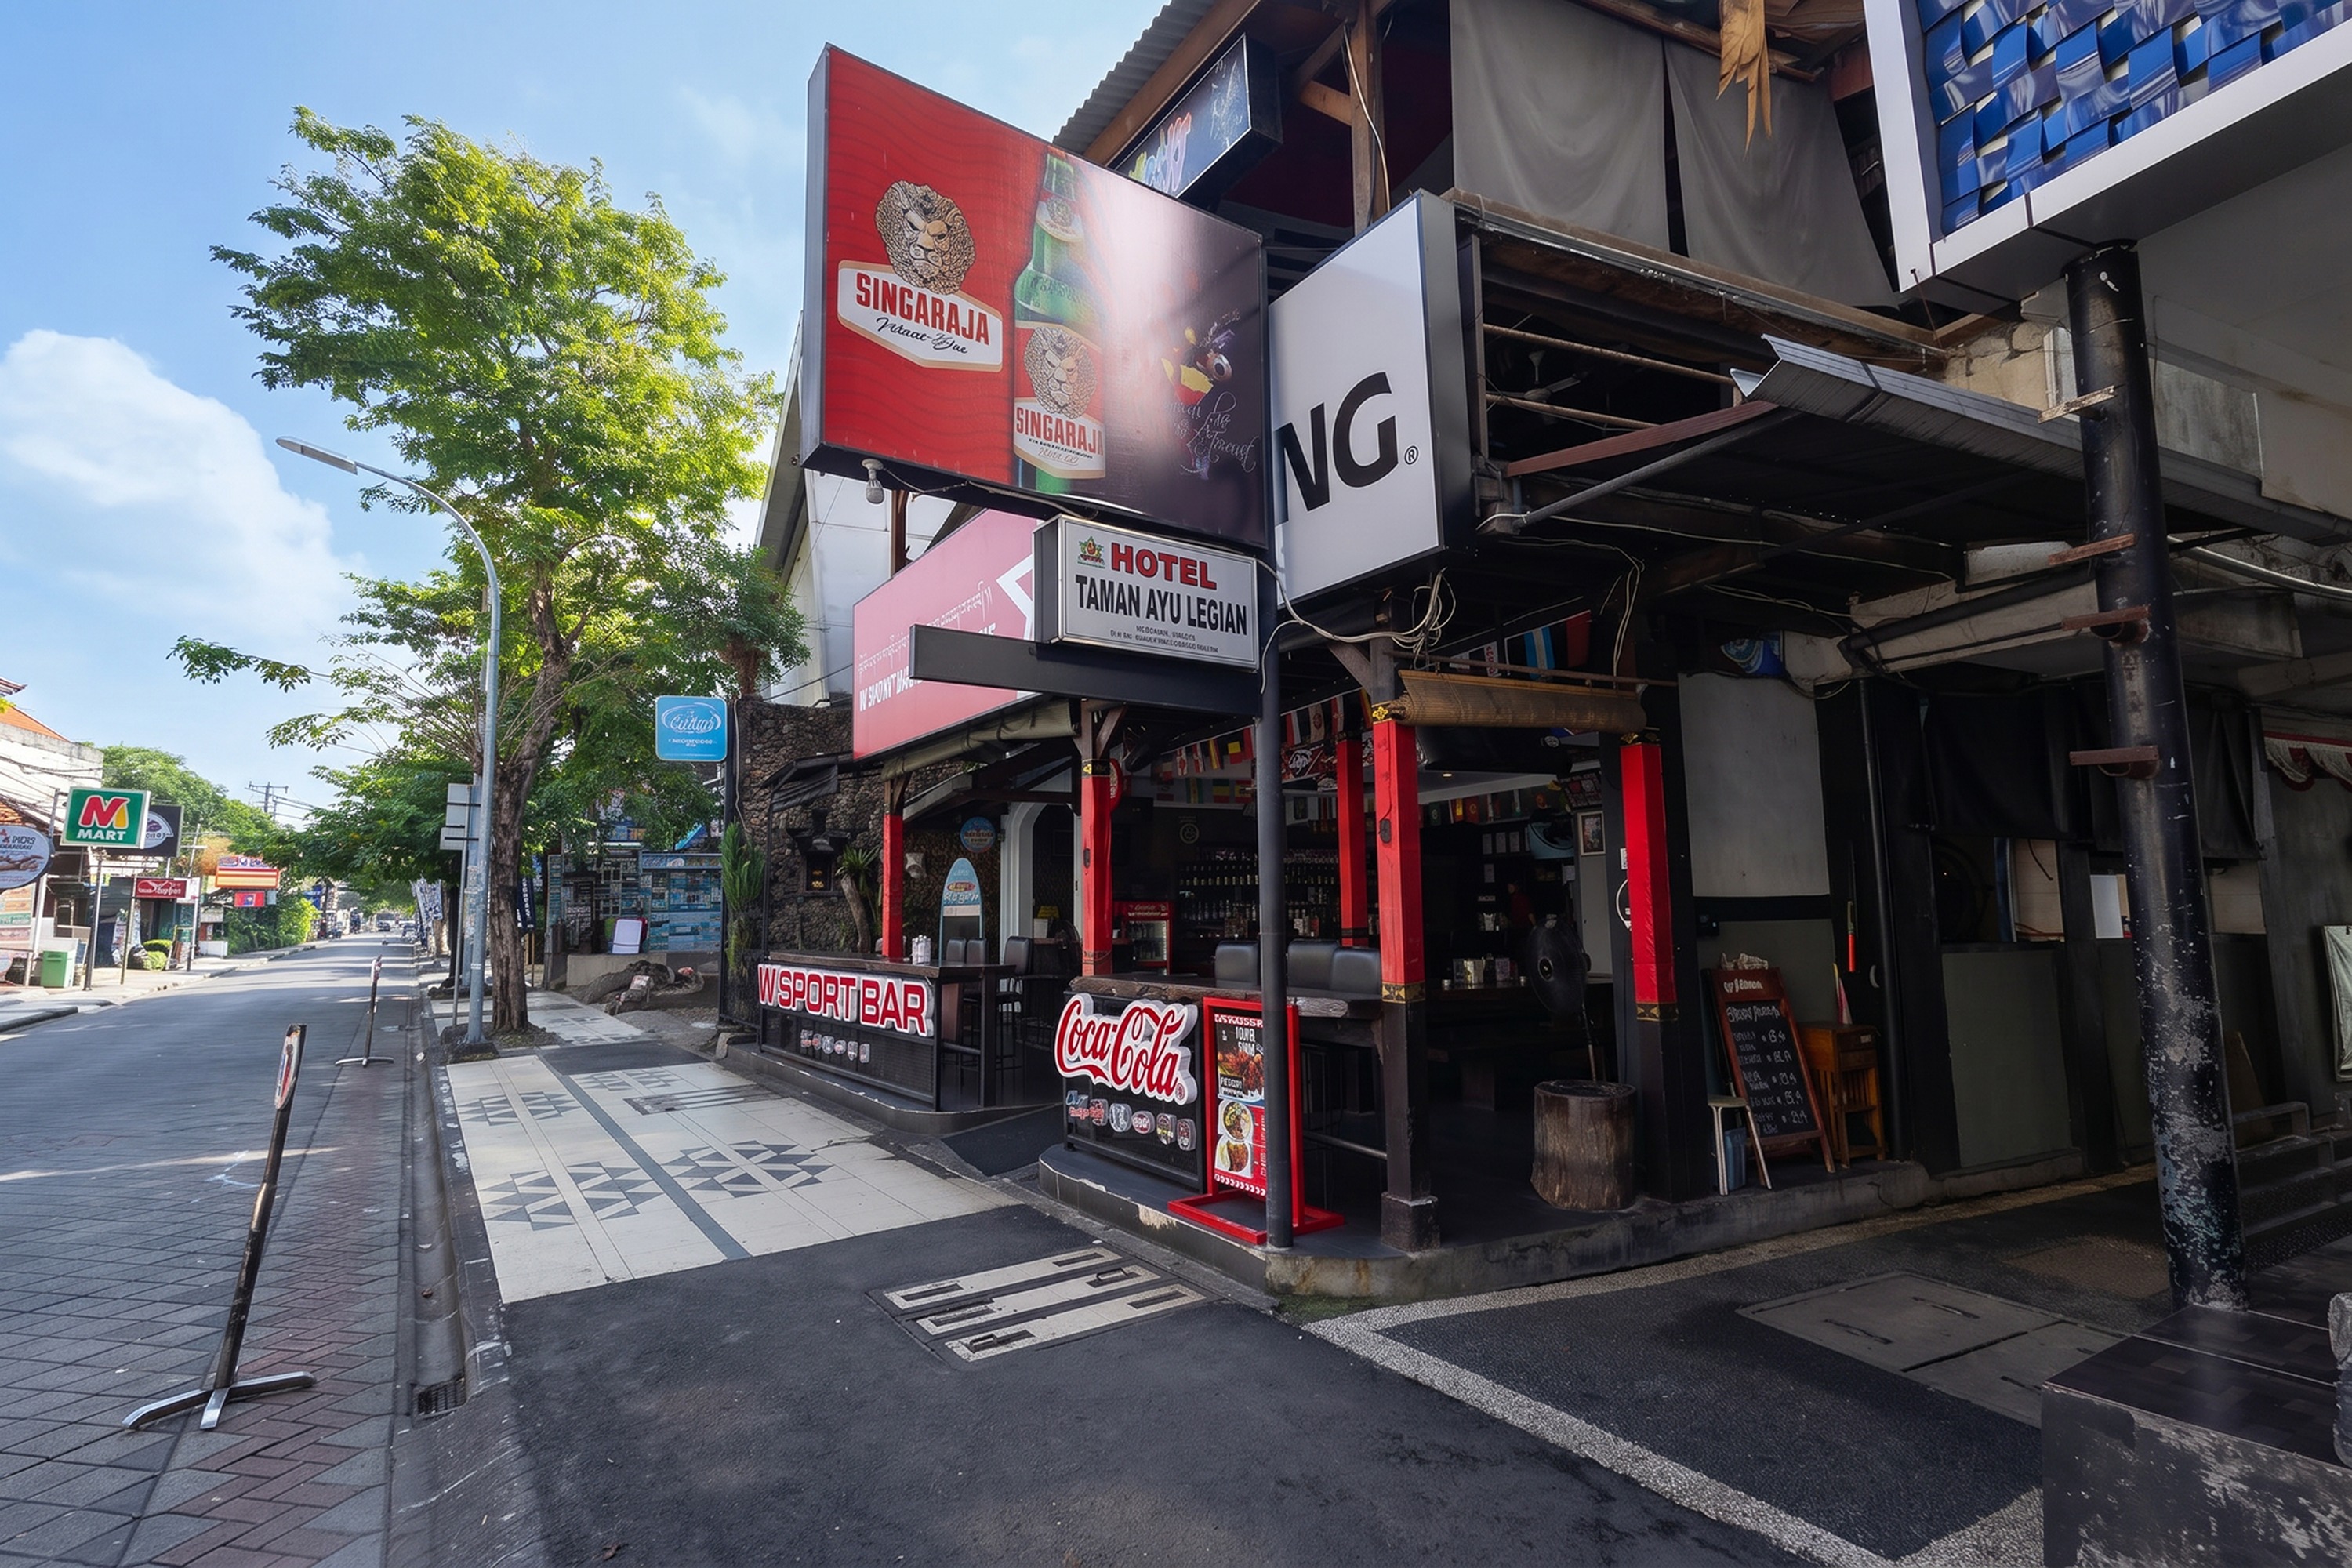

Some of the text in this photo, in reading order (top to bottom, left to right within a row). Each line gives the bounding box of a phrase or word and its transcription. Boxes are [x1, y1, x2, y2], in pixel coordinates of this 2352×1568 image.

[856, 272, 990, 346] SINGARAJA
[1016, 407, 1105, 456] SINGARAJA
[1111, 542, 1218, 591] HOTEL
[1075, 574, 1141, 619] TAMAN
[1145, 588, 1181, 625] AYU
[1186, 594, 1248, 637] LEGIAN
[76, 829, 126, 840] MART
[860, 978, 928, 1036] BAR
[1055, 998, 1186, 1098] Coca-Cola
